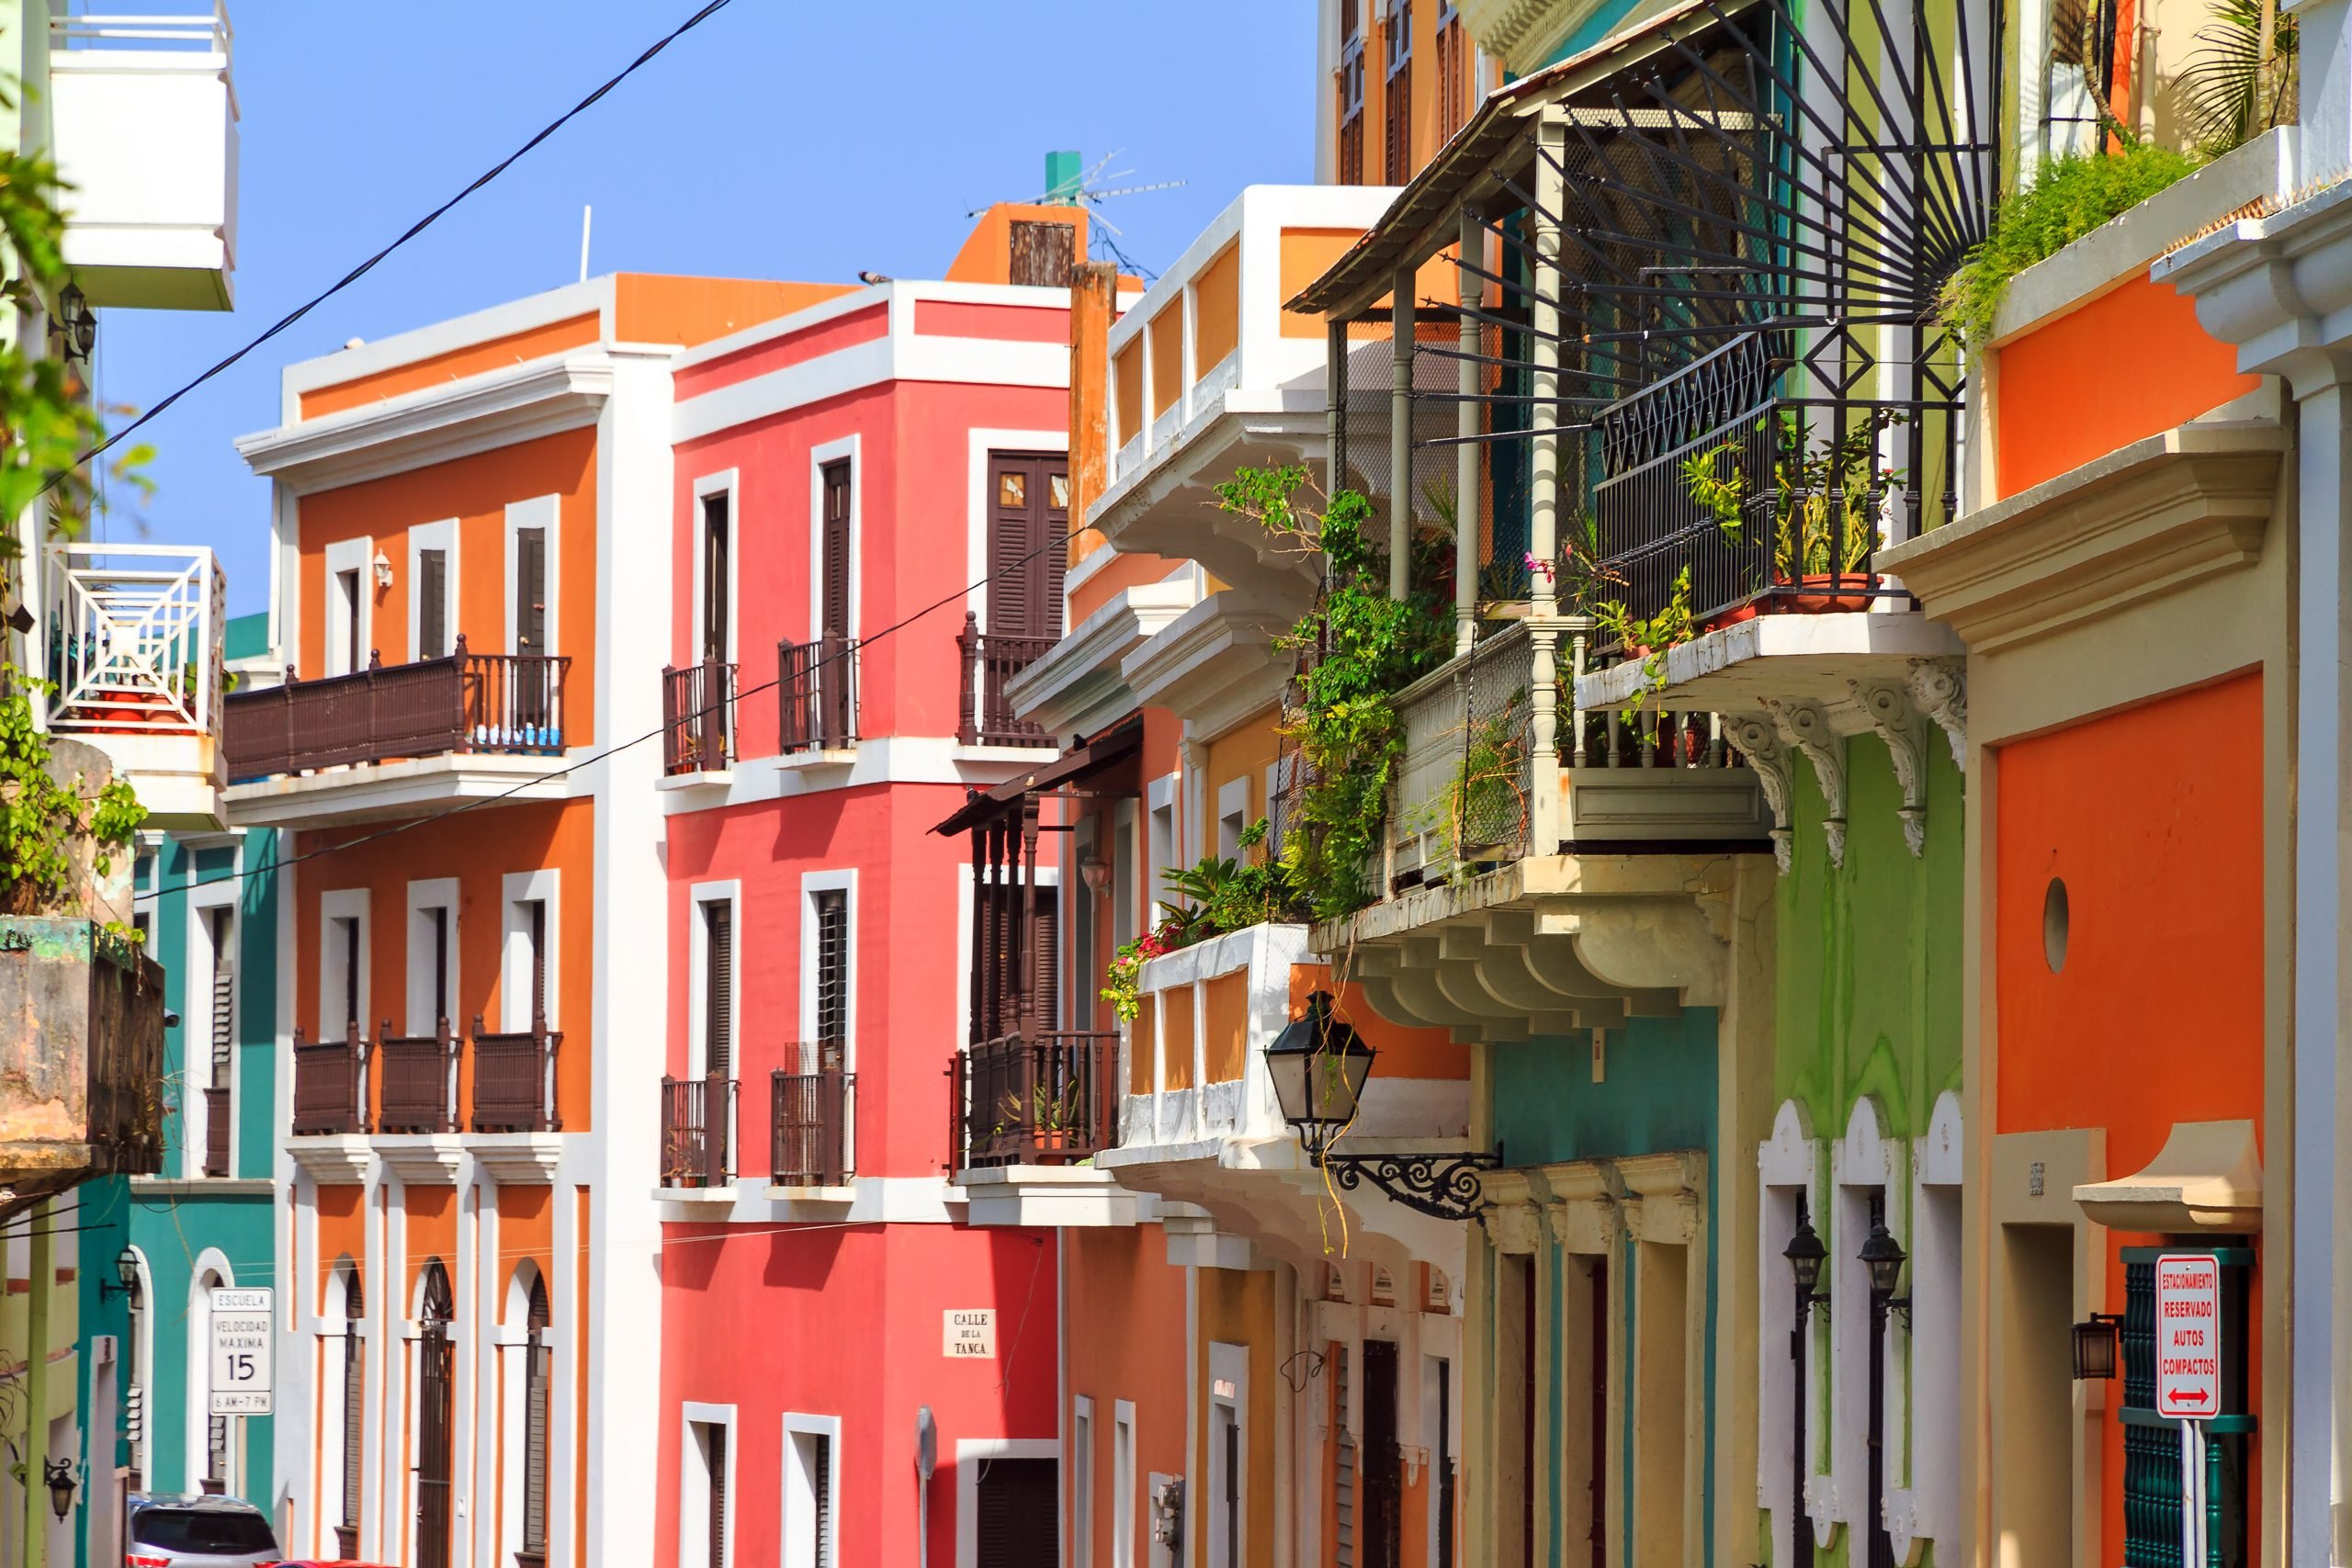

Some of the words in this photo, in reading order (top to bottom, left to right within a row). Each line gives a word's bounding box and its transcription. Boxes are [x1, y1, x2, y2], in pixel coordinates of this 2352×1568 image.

[2163, 1273, 2212, 1290] ESTACIONAMIENTO
[219, 1294, 265, 1305] ESCUELA
[2165, 1301, 2212, 1318] RESERVADO
[955, 1314, 988, 1325] CALLE
[216, 1321, 268, 1332] VELOCIDAD
[971, 1330, 981, 1338] LA
[2174, 1329, 2204, 1347] AUTOS
[219, 1337, 265, 1348] MAXIMA
[955, 1343, 986, 1354] TANCA
[228, 1354, 254, 1381] 15
[2163, 1359, 2214, 1375] COMPACTOS
[254, 1396, 267, 1407] PM
